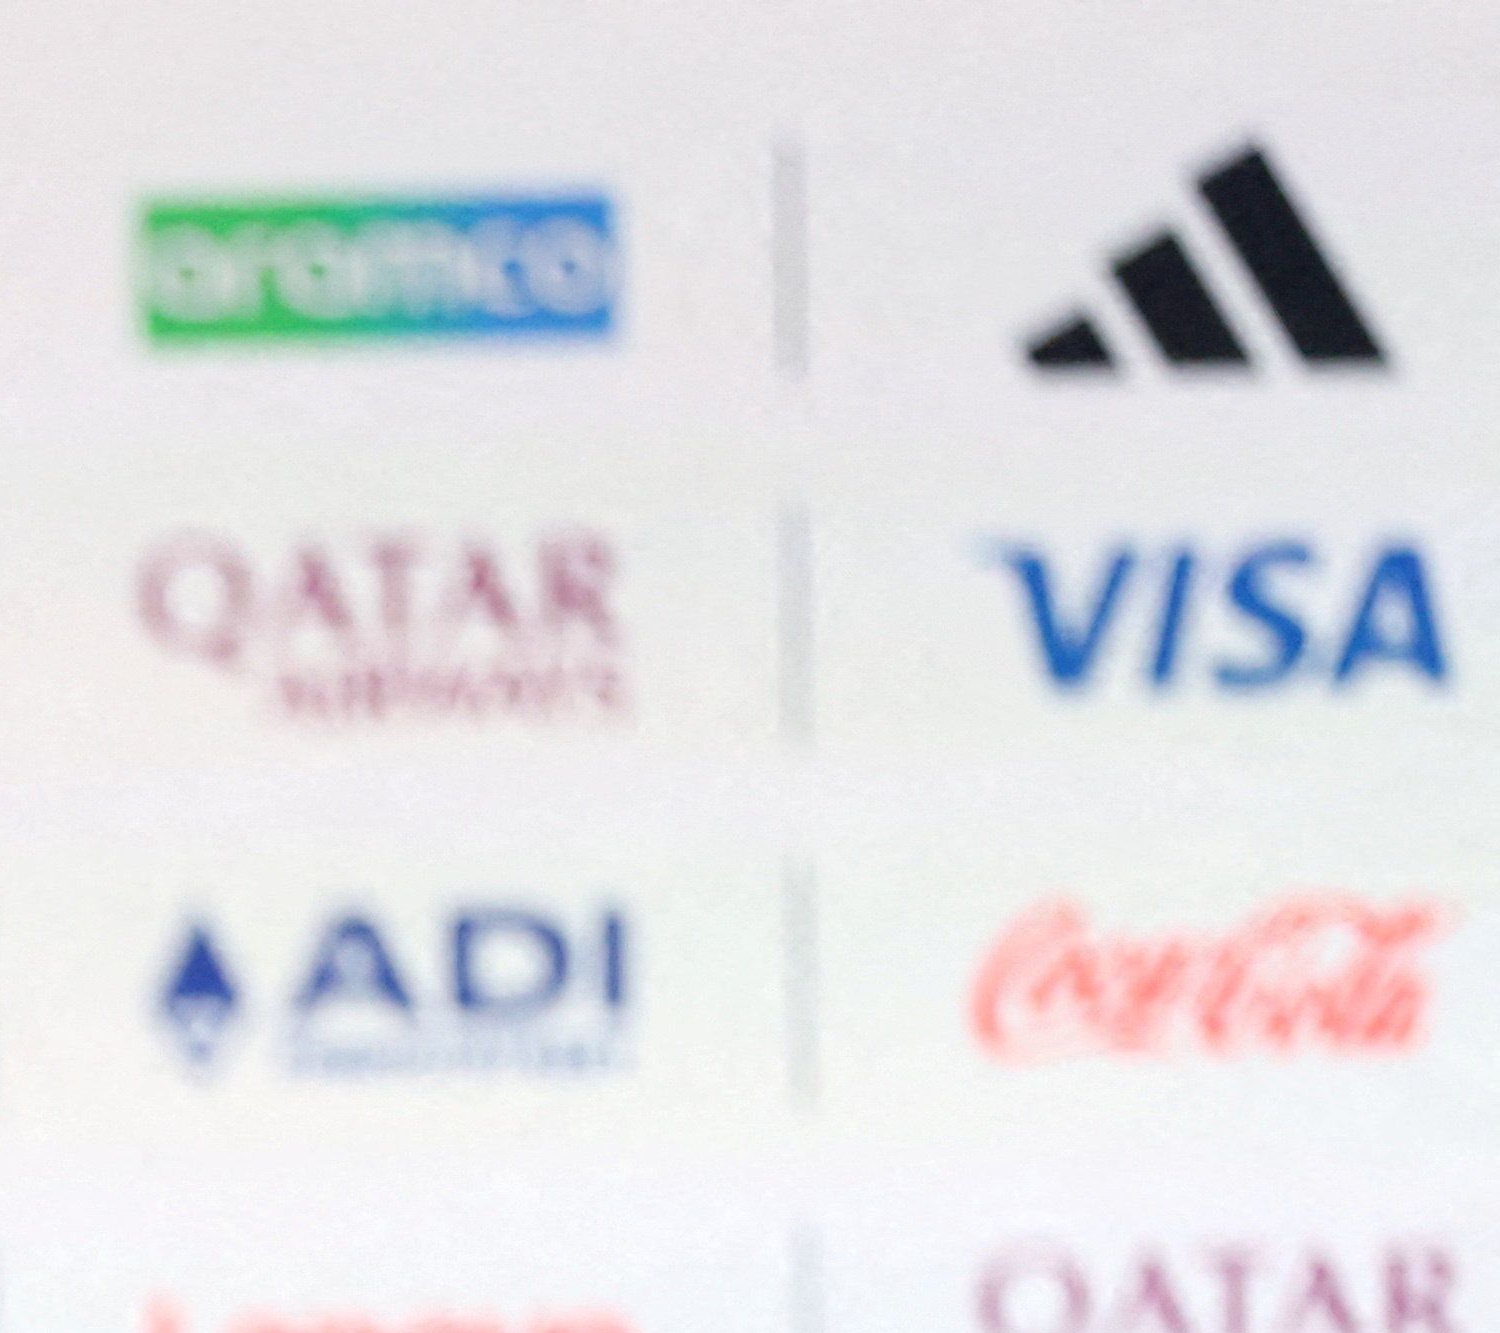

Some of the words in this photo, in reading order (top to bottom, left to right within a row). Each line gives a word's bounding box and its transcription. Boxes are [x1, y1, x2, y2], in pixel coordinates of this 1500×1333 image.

[142, 224, 616, 326] aramco
[138, 534, 619, 668] QATAR
[994, 540, 1450, 692] VISA
[293, 907, 630, 1020] ADI
